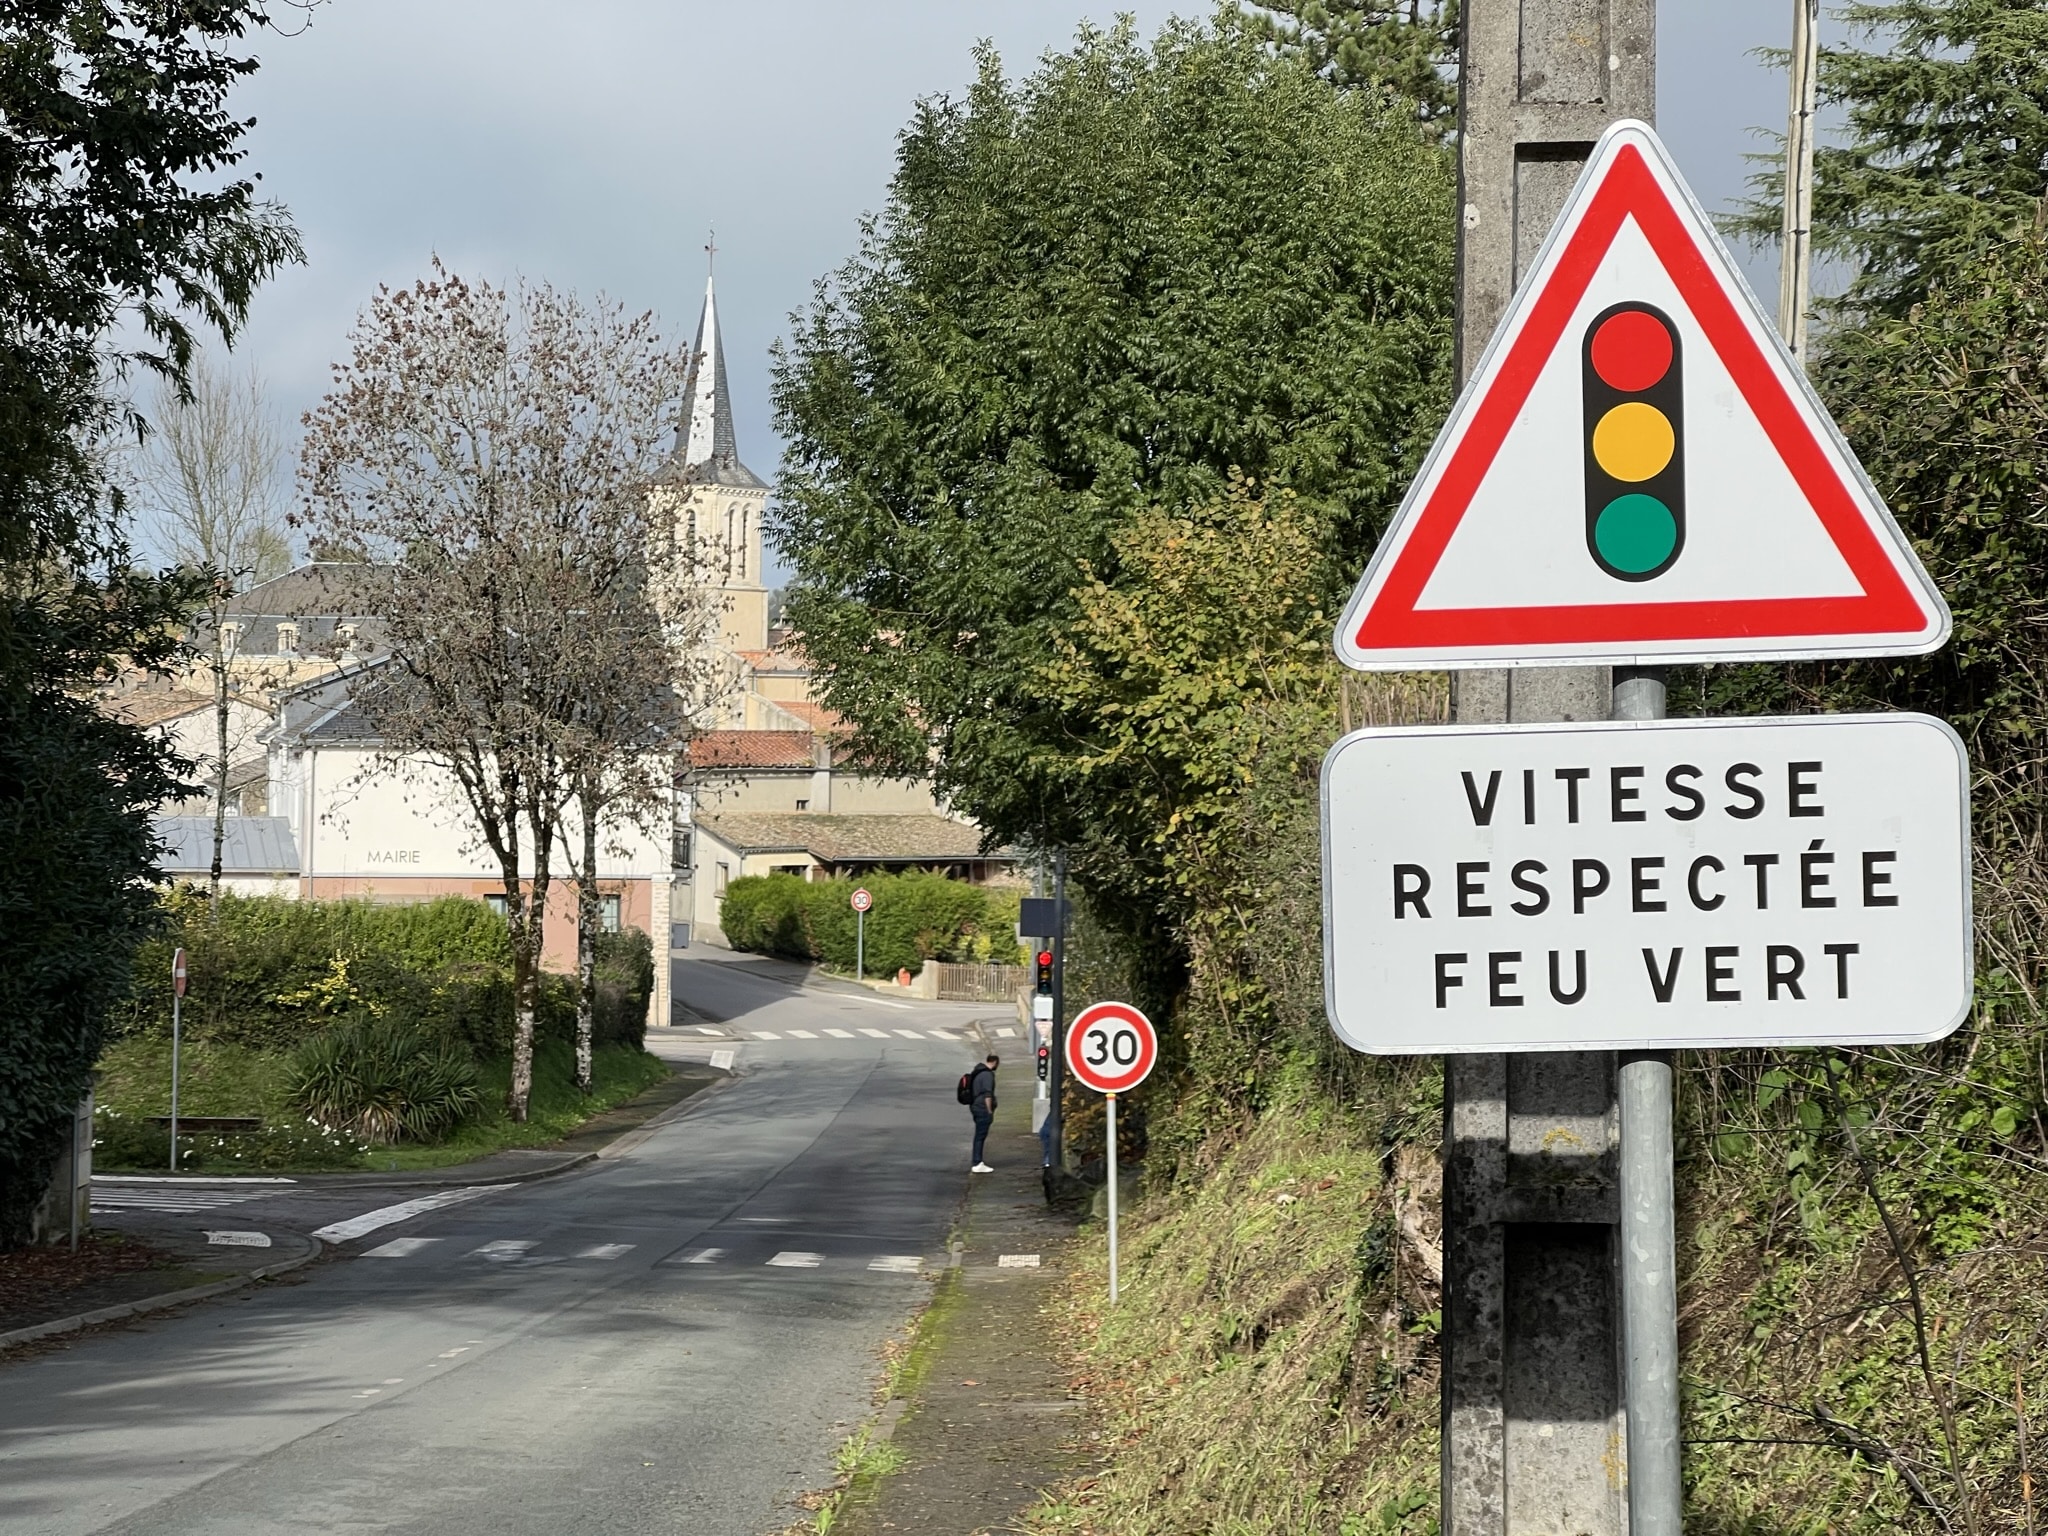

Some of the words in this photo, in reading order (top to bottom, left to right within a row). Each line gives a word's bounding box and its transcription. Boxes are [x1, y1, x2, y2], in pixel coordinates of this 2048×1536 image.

[1461, 760, 1826, 826] VITESSE
[367, 850, 421, 863] MAIRIE
[1393, 838, 1900, 919] RESPECTÉE
[856, 896, 867, 904] 30
[1434, 949, 1588, 1009] FEU
[1642, 943, 1861, 1002] VERT
[1086, 1029, 1137, 1066] 30
